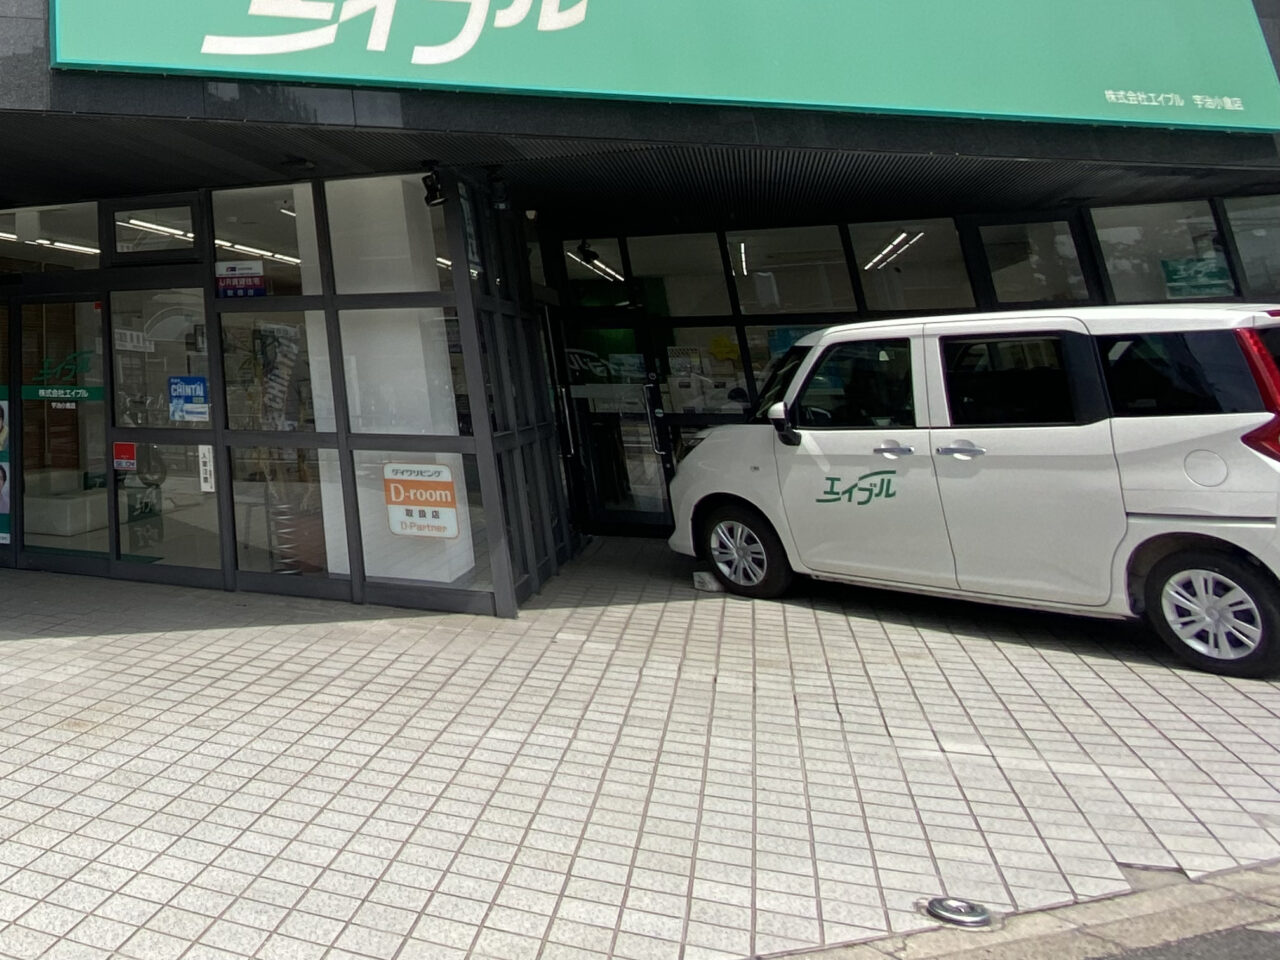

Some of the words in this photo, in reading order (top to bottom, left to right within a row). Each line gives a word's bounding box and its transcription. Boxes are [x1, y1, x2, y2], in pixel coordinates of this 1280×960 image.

[170, 382, 204, 397] CHINTAI
[391, 469, 444, 478] ダイワリビング
[390, 483, 452, 502] D-room
[816, 470, 897, 505] エイブル
